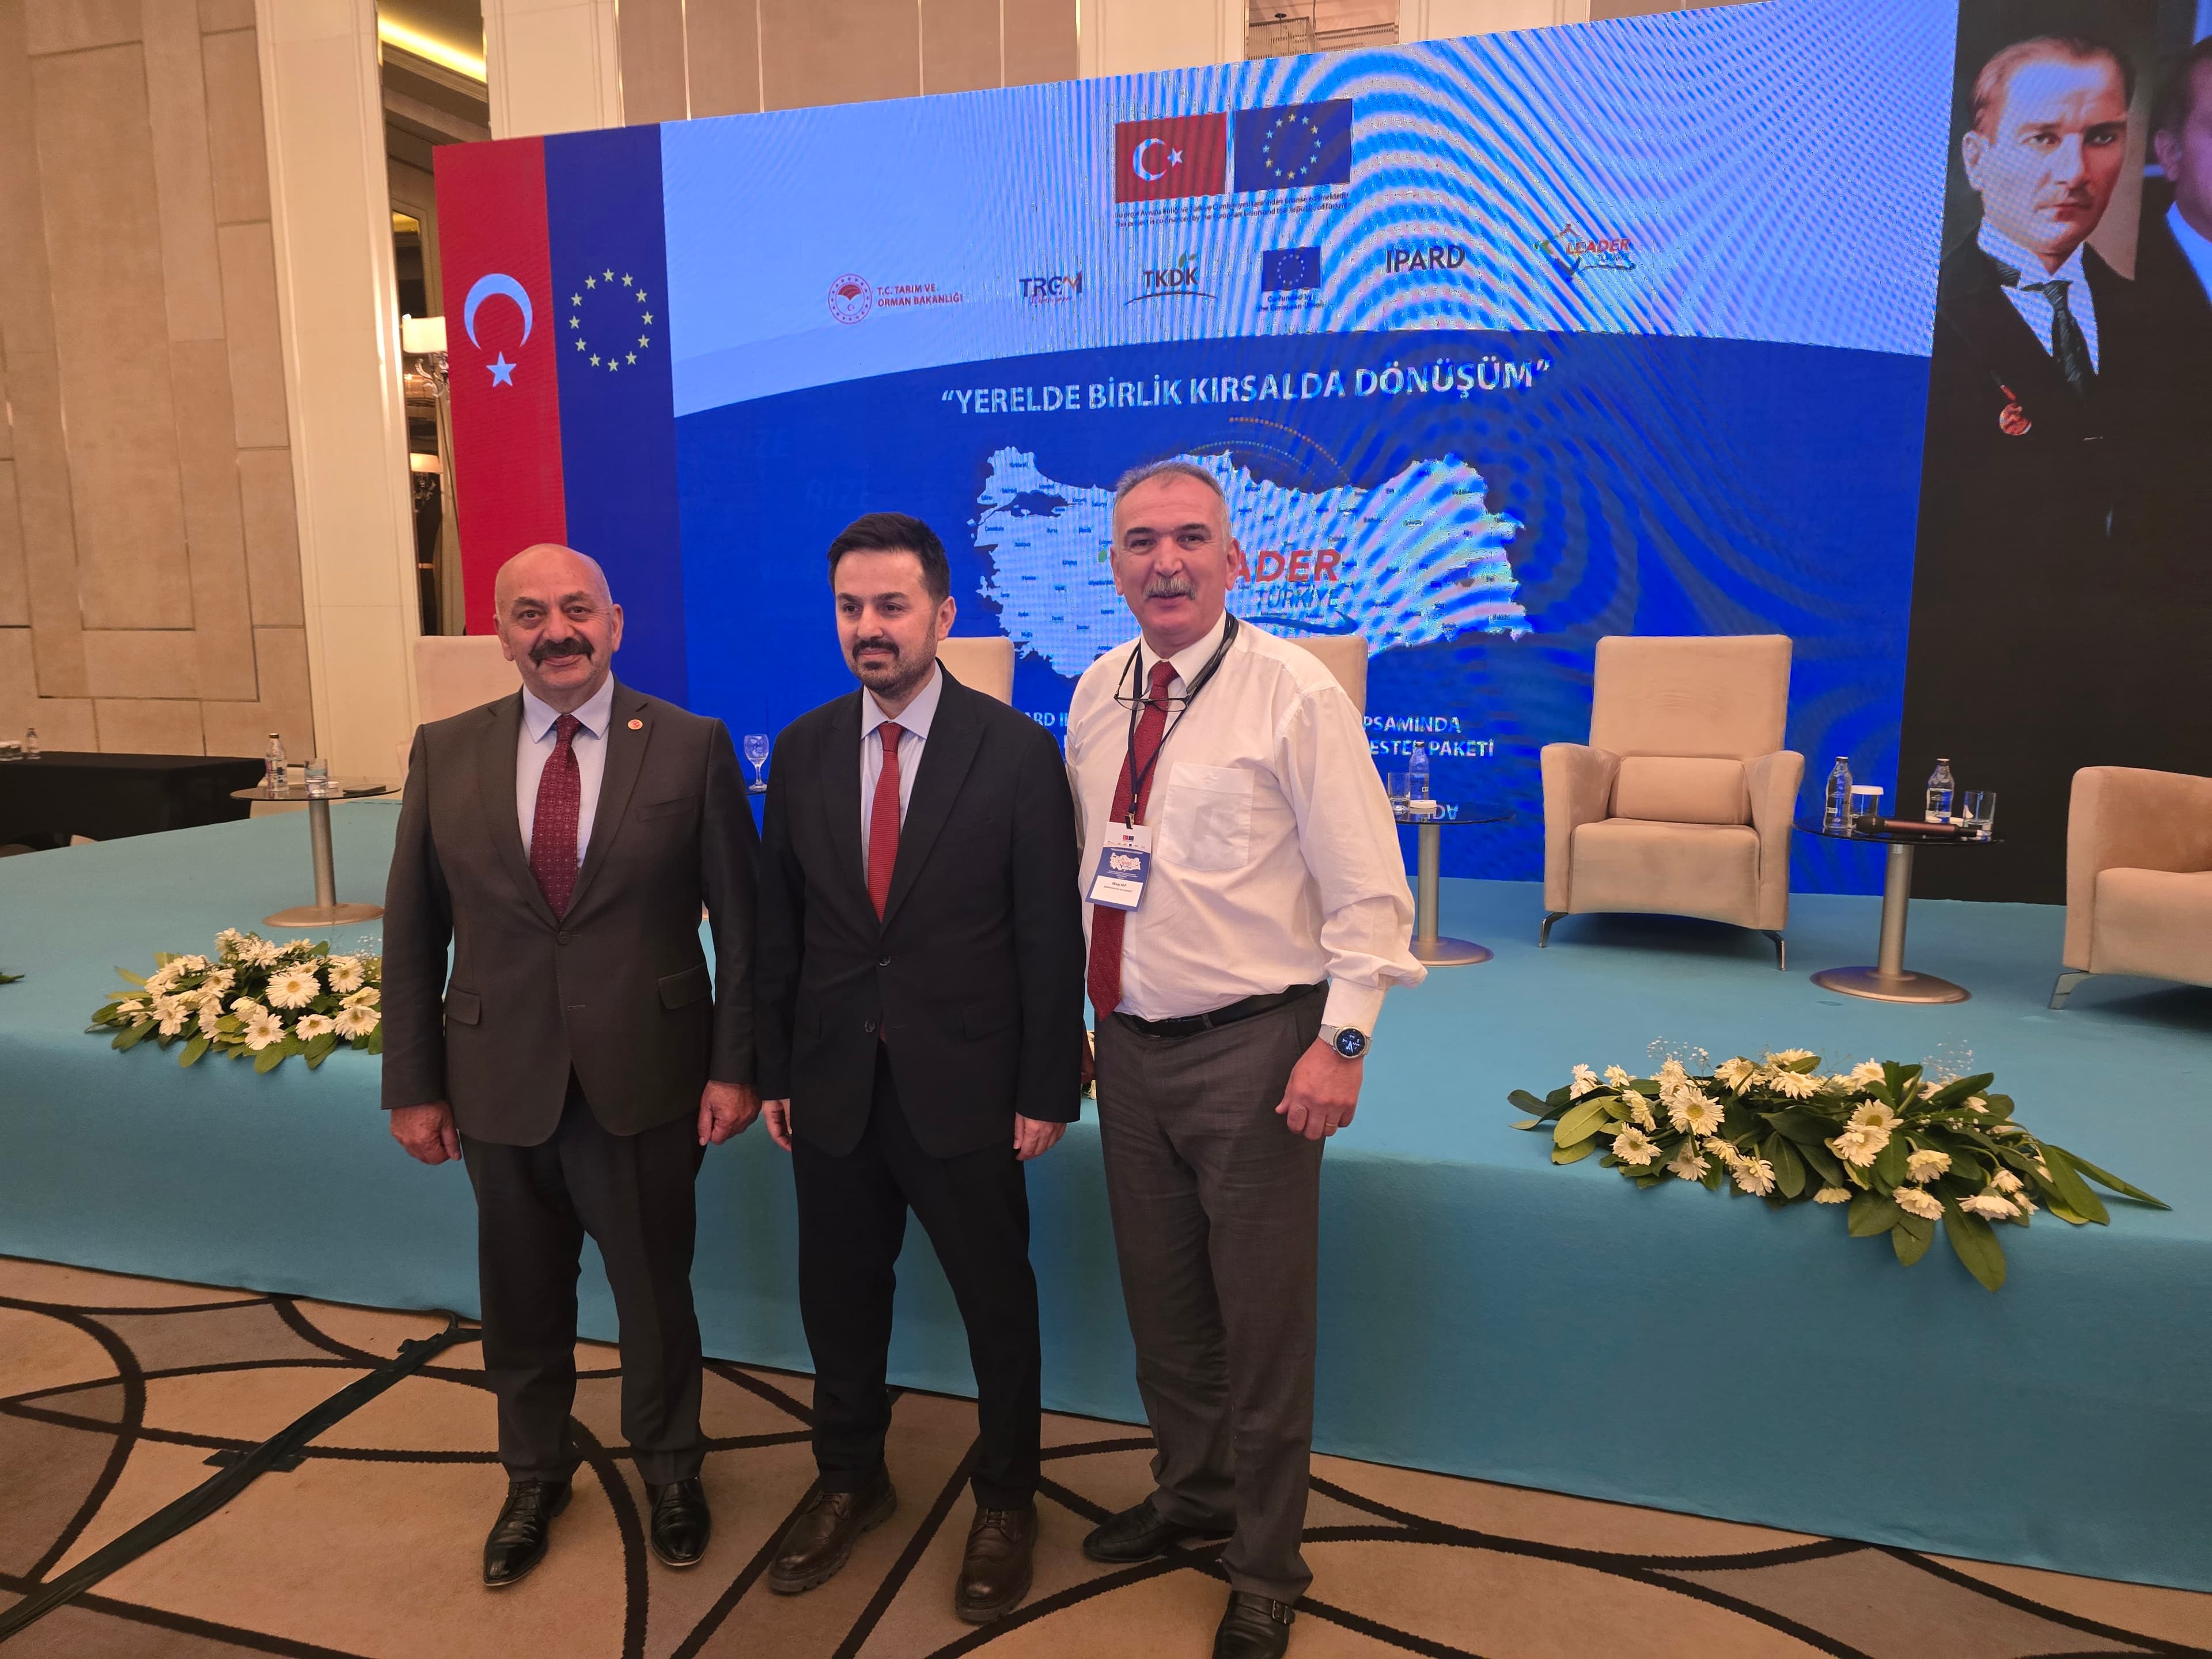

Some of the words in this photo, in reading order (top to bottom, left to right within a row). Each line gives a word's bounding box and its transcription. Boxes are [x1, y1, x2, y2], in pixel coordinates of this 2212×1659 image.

[1566, 238, 1630, 255] LEADER
[1385, 245, 1464, 273] IPARD
[1143, 267, 1198, 288] TKDK
[894, 284, 922, 294] TARIM
[925, 283, 935, 292] VE
[878, 296, 911, 307] ORMAN
[914, 291, 963, 305] BAKANLIĞI
[942, 385, 1080, 414] “YERELDE
[1089, 374, 1182, 410] BİRLİK
[1191, 370, 1345, 404] KIRSALDA
[1355, 356, 1551, 399] DÖNÜŞÜM”
[1025, 711, 1055, 726] RD
[1429, 738, 1494, 757] PAKETİ
